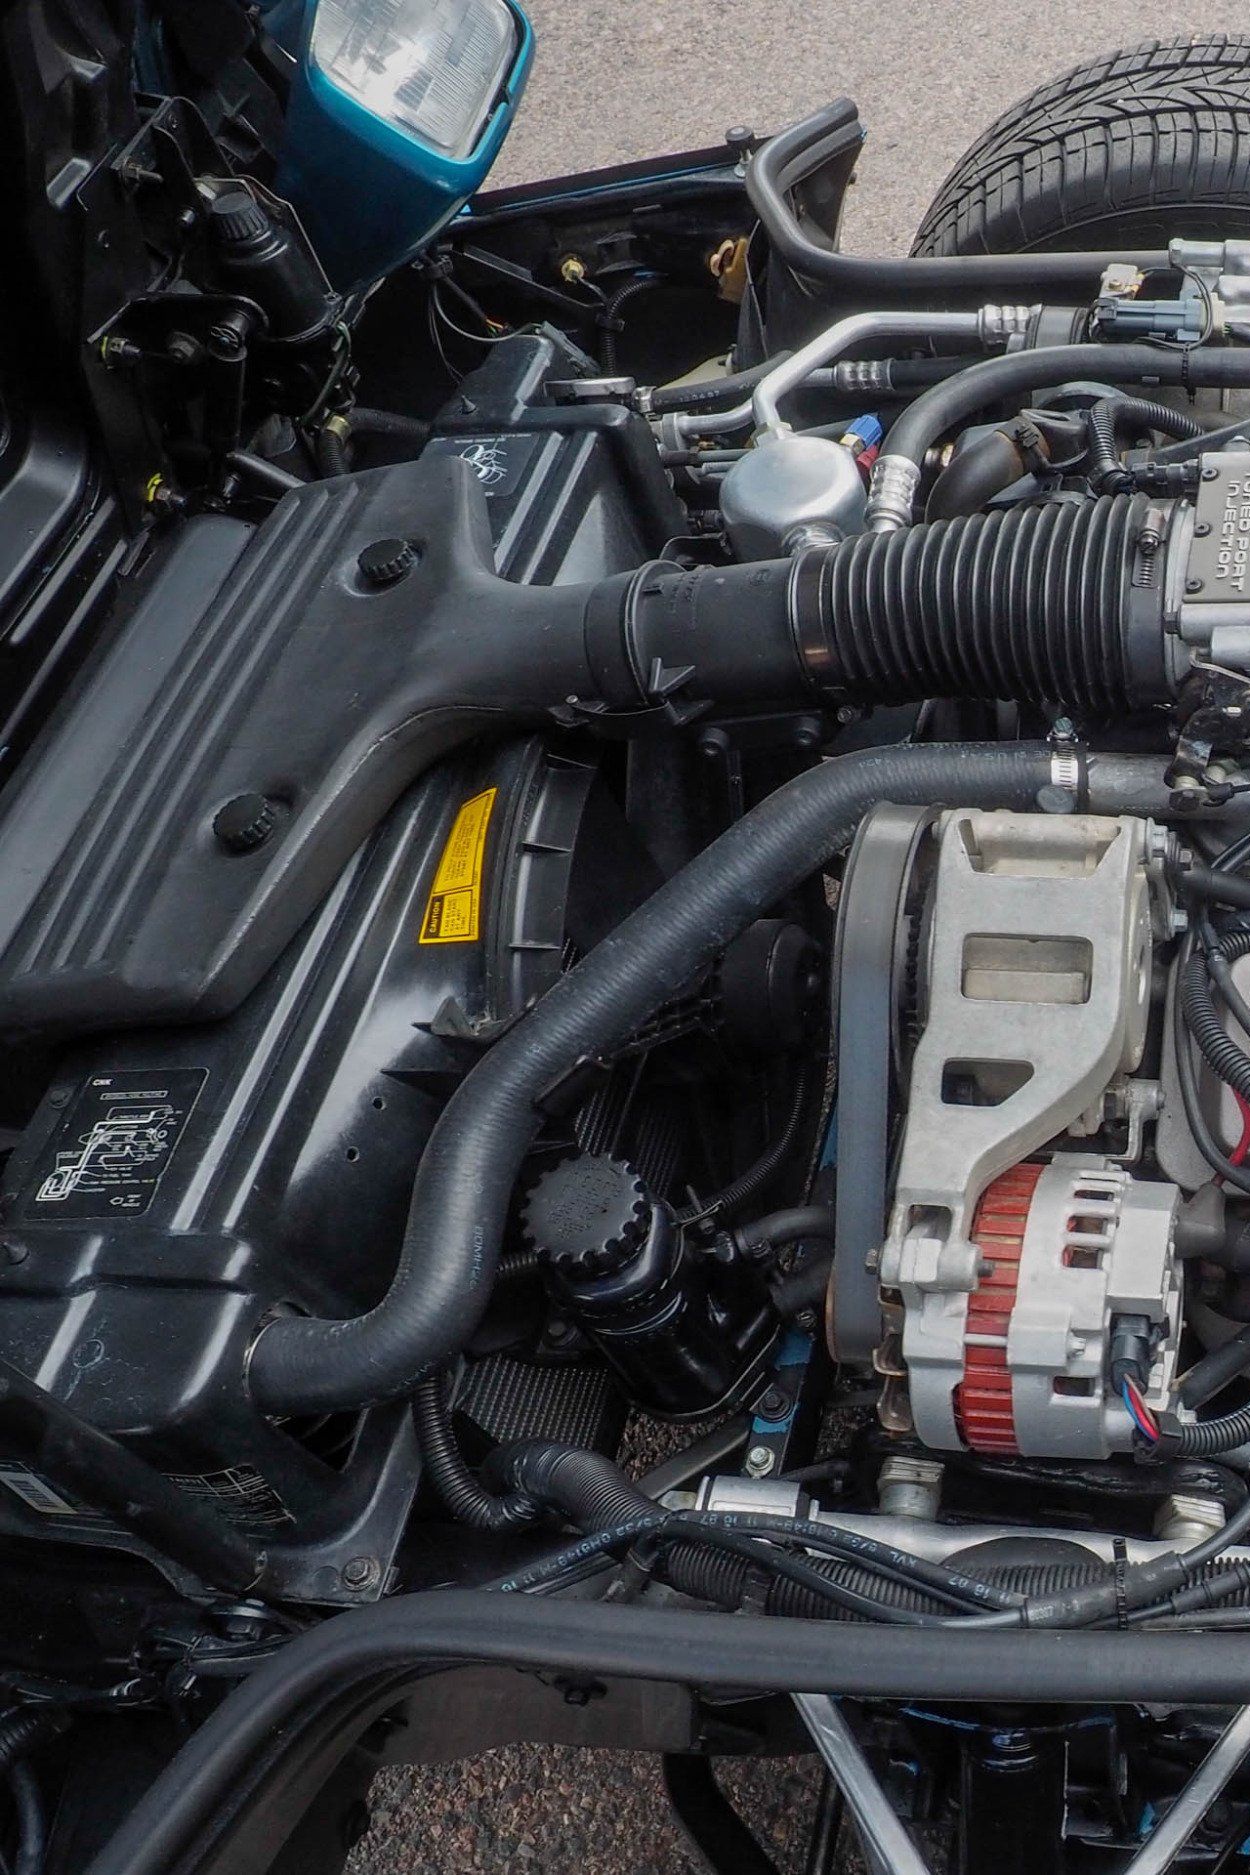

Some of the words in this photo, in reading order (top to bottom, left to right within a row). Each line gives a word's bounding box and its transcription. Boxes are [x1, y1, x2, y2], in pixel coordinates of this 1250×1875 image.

[1215, 480, 1241, 580] INJECTION
[1229, 537, 1250, 592] PORT
[429, 901, 442, 933] CAUTION
